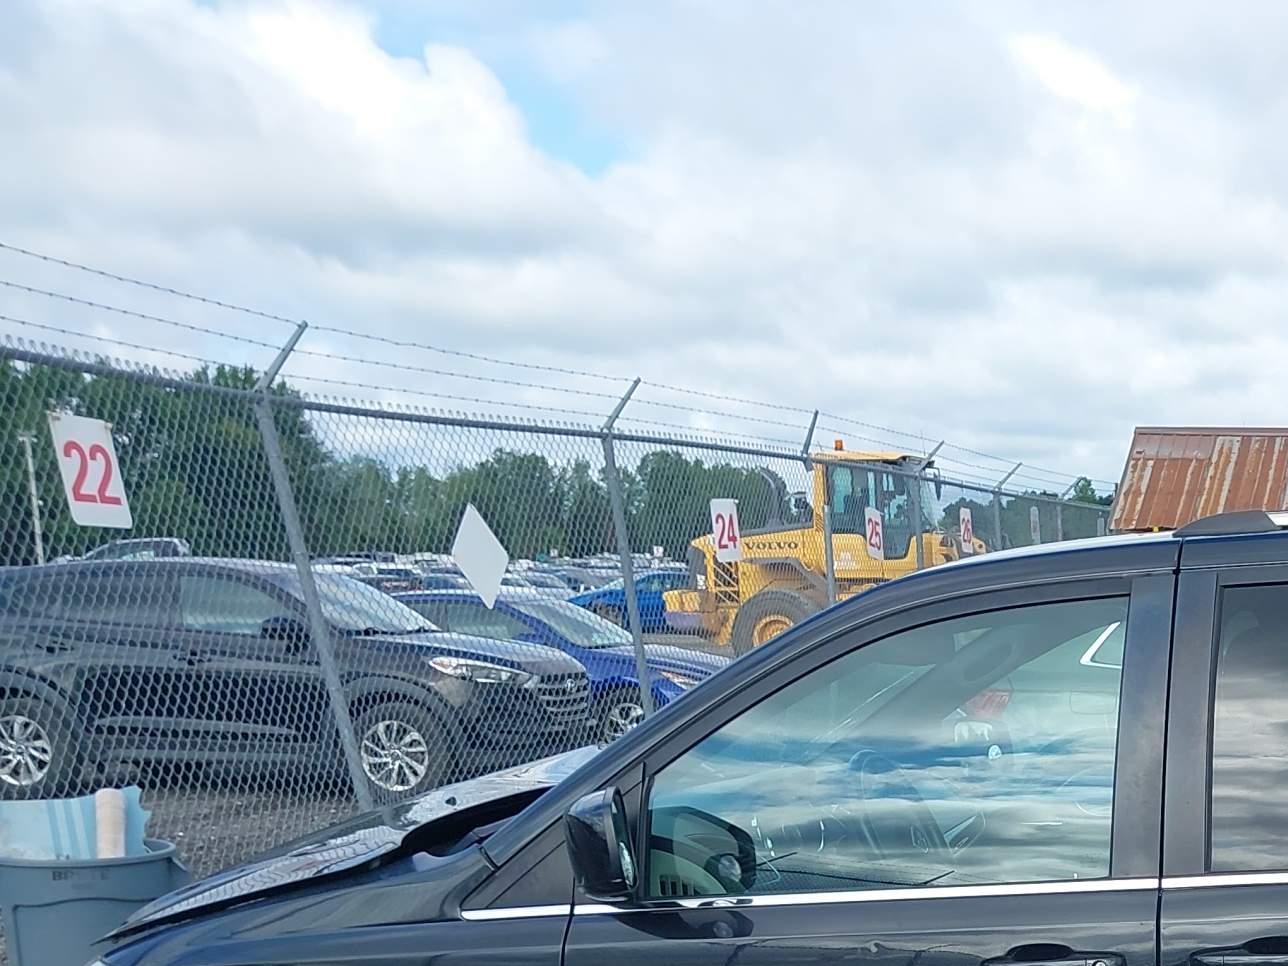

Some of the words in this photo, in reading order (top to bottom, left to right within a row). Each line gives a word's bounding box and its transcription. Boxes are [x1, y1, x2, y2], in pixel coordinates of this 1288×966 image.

[63, 440, 123, 506] 22
[715, 512, 738, 549] 24
[744, 541, 798, 550] VOLVO
[867, 517, 882, 551] 25
[961, 517, 972, 544] 26
